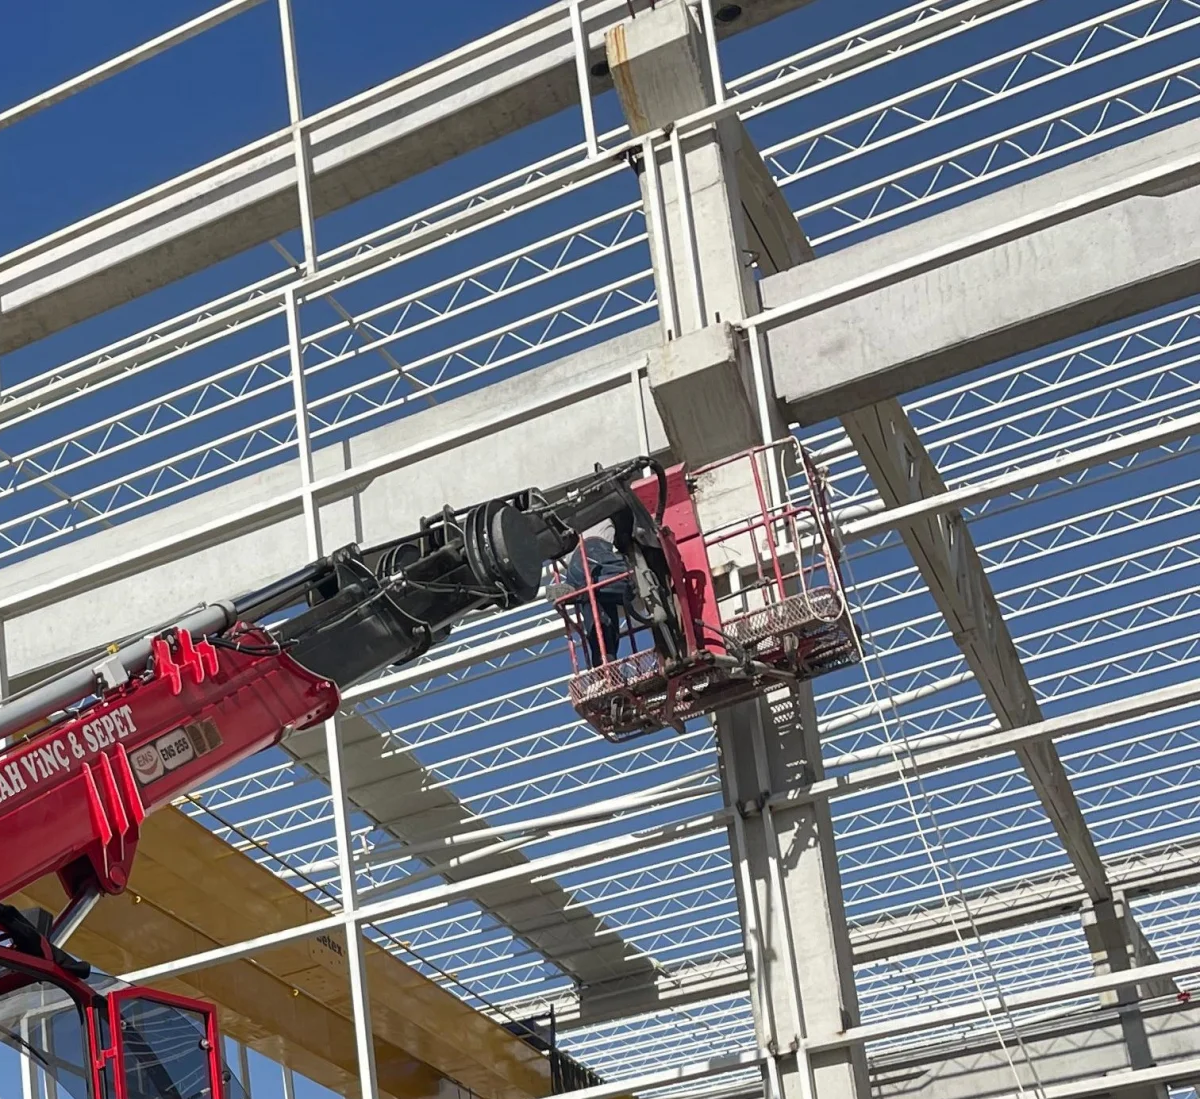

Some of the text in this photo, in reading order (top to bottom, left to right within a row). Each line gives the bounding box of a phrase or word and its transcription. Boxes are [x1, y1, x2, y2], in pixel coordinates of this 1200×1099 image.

[67, 732, 86, 759] &
[82, 704, 137, 753] SEPET
[136, 751, 154, 767] ENS
[160, 744, 176, 761] ENS
